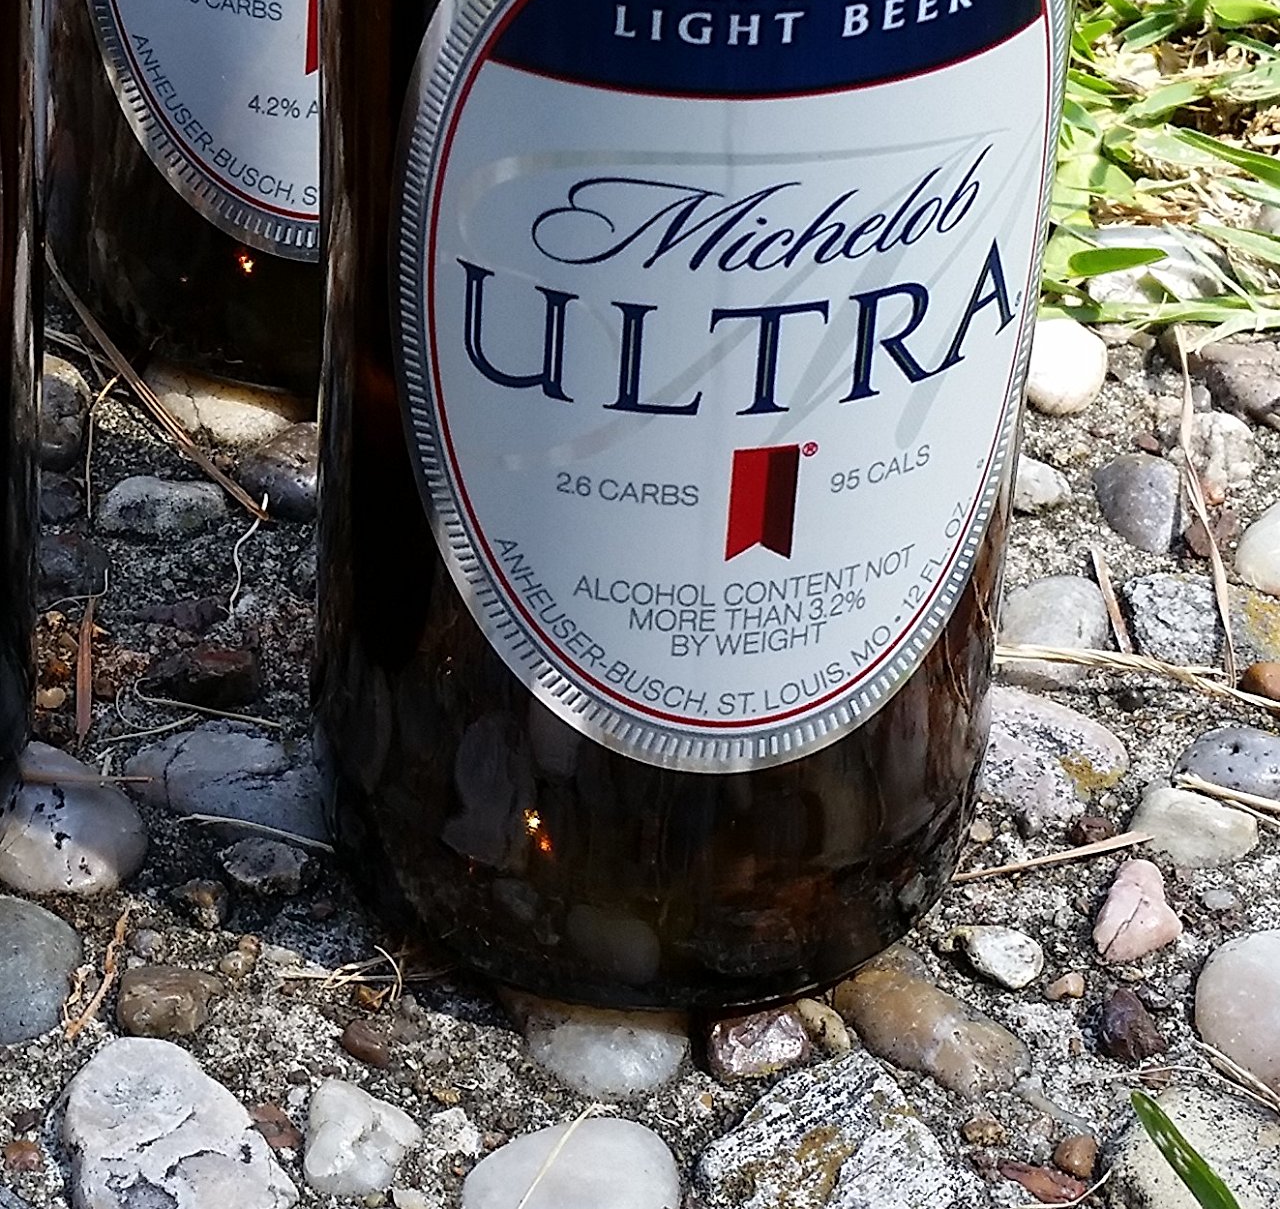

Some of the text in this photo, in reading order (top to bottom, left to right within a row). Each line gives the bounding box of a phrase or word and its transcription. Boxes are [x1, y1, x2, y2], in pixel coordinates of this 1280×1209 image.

[614, 4, 805, 46] LIGHT
[131, 33, 295, 205] ANHEUSER-BUSCH,
[247, 94, 300, 120] 4.2%
[530, 143, 994, 272] Michelob
[455, 237, 1017, 417] ULTRA
[555, 472, 700, 507] 2.6 CARBS
[830, 444, 931, 493] 95 CALS
[572, 543, 916, 608] ALCOHOL CONTENT NOT
[493, 537, 709, 716] ANHEUSER-BUSCH,
[717, 691, 757, 716] ST.
[764, 661, 851, 711] LOUIS,
[850, 624, 891, 668] MO
[903, 584, 927, 611] 12
[920, 545, 951, 584] FL.
[629, 588, 866, 633] MORE THAN 3.2%
[671, 621, 827, 657] BY WEIGHT
